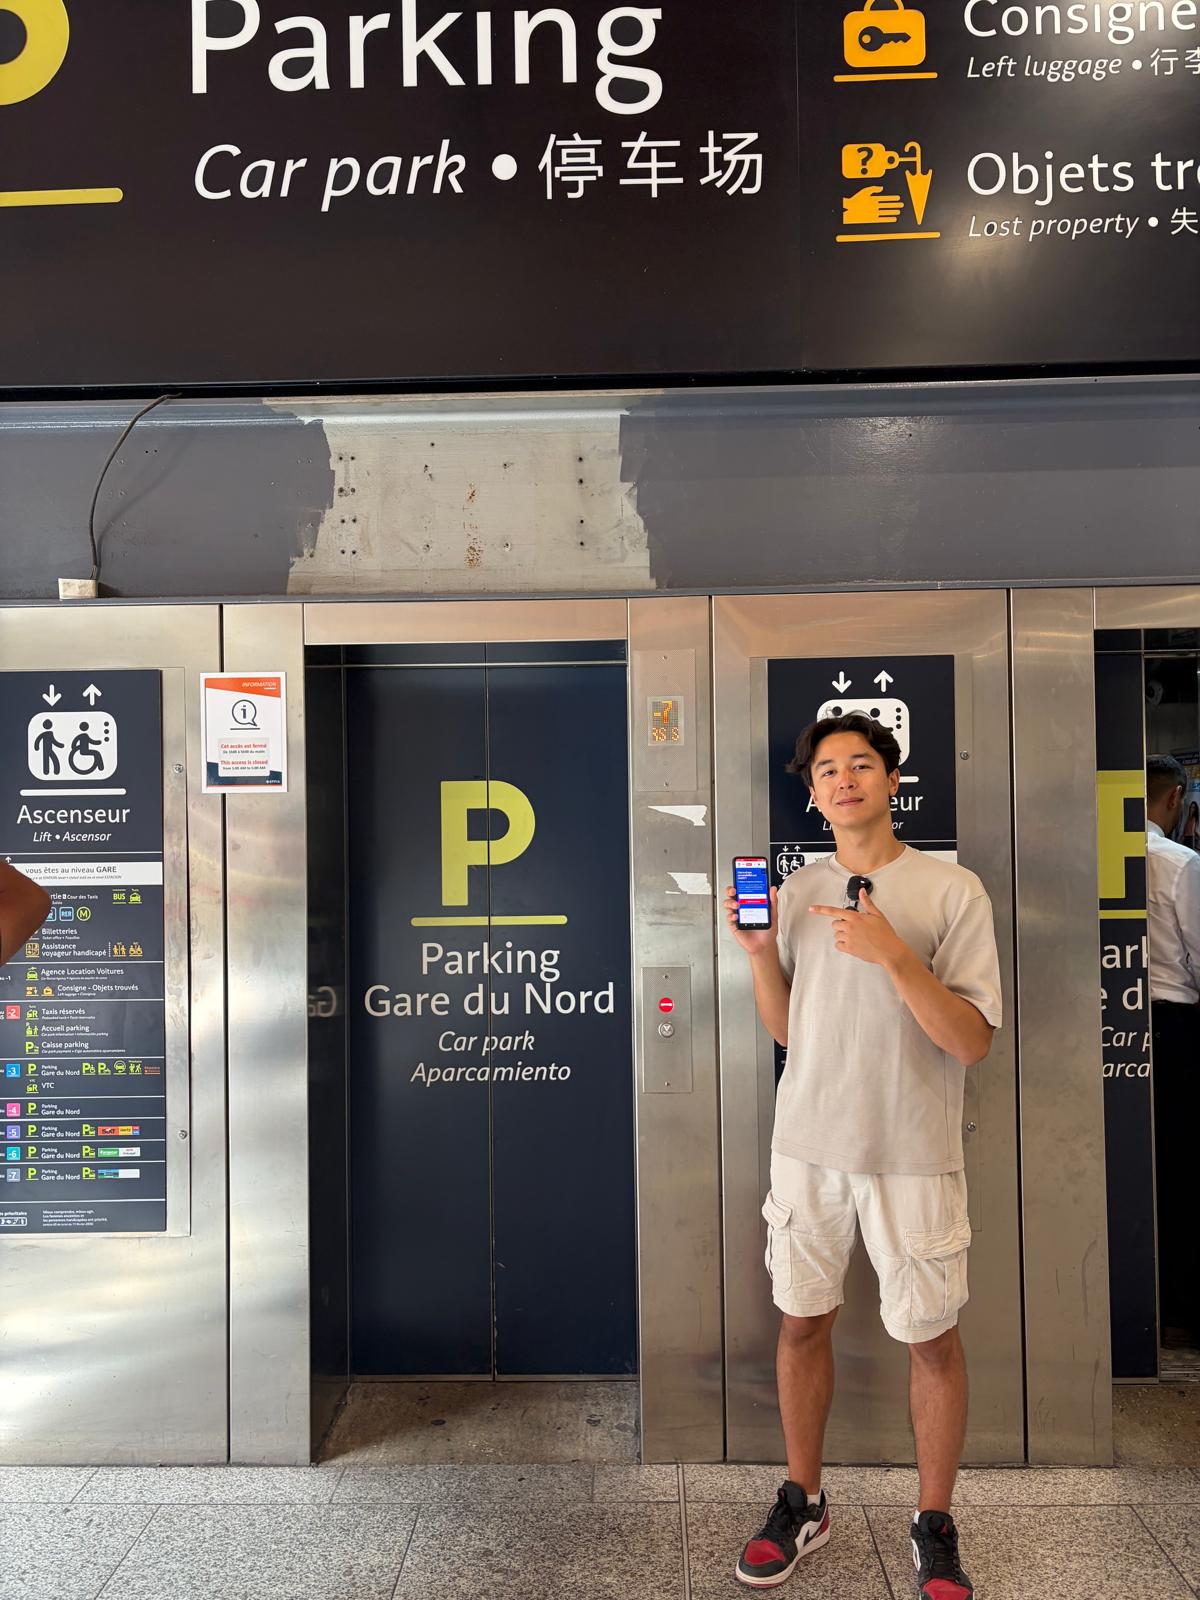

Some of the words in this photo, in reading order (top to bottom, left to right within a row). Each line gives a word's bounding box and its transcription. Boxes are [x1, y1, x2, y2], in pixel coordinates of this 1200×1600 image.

[963, 0, 1198, 45] Consigne
[191, 0, 663, 115] Parking
[967, 55, 1018, 78] Left
[1024, 55, 1123, 83] luggage
[194, 144, 307, 200] Car
[321, 138, 466, 212] park
[537, 130, 763, 200] 停车场
[967, 151, 1135, 206] Objets
[1151, 152, 1200, 191] tr
[969, 215, 1023, 238] Lost
[1028, 213, 1140, 242] property
[16, 804, 130, 824] Ascenseur
[33, 831, 52, 842] Lift
[62, 831, 112, 841] Ascensor
[440, 780, 536, 906] P
[44, 866, 59, 874] êtes
[41, 927, 77, 935] Billetteries
[41, 968, 65, 976] Agence
[97, 967, 124, 975] Voitures
[422, 941, 561, 983] Parking
[57, 984, 86, 993] Consigne
[92, 984, 113, 992] Objets
[364, 984, 450, 1017] Gare
[463, 983, 509, 1015] du
[525, 982, 615, 1015] Nord
[64, 1041, 88, 1049] parking
[438, 1031, 477, 1051] Car
[482, 1030, 535, 1056] park
[410, 1061, 571, 1087] Aparcamiento
